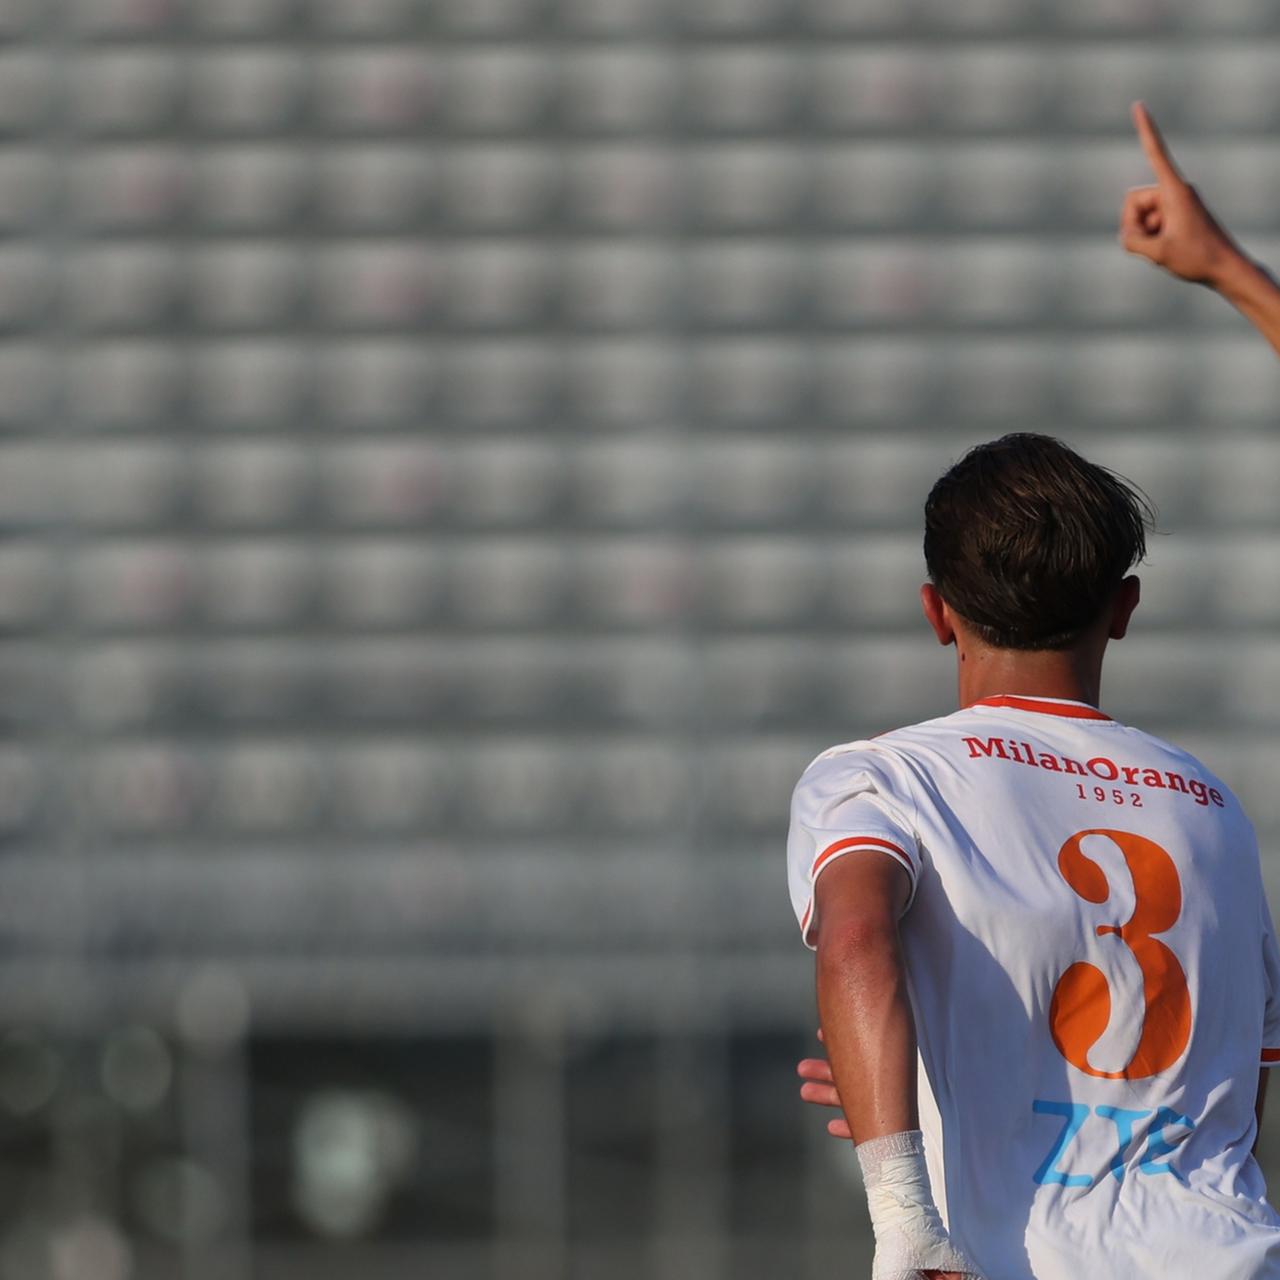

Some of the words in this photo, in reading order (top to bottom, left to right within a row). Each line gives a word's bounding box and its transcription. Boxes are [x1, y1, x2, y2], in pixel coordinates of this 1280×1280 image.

[962, 737, 1224, 807] MilanOrange
[1076, 784, 1143, 807] 1952
[1049, 829, 1191, 1079] 3
